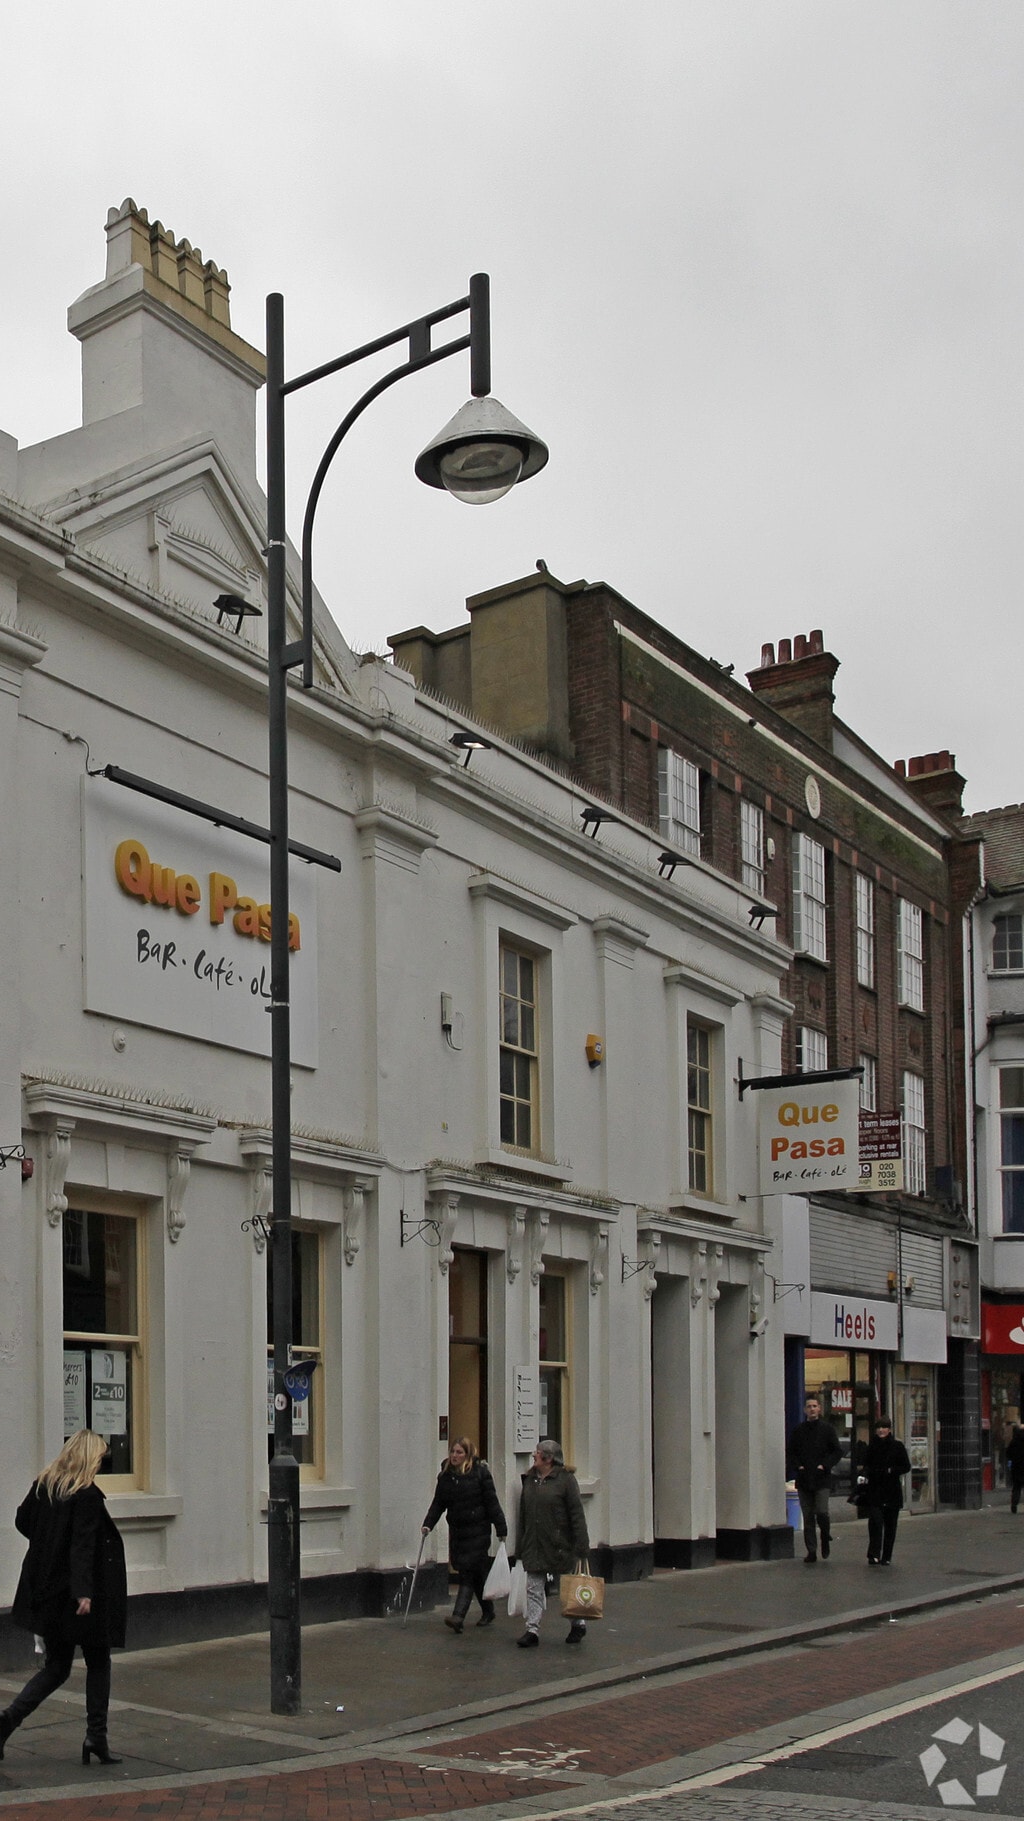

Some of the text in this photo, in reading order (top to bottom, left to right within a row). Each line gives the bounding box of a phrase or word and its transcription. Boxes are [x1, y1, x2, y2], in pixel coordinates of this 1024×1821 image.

[114, 839, 301, 952] Que Pasa
[778, 1102, 839, 1127] Que
[771, 1137, 845, 1161] Pasa
[877, 1171, 896, 1179] 7038
[879, 1163, 893, 1171] 020
[878, 1179, 896, 1187] 3512
[835, 1304, 876, 1340] Heels
[94, 1385, 101, 1398] 2
[109, 1386, 124, 1398] £10
[831, 1389, 852, 1408] SALE
